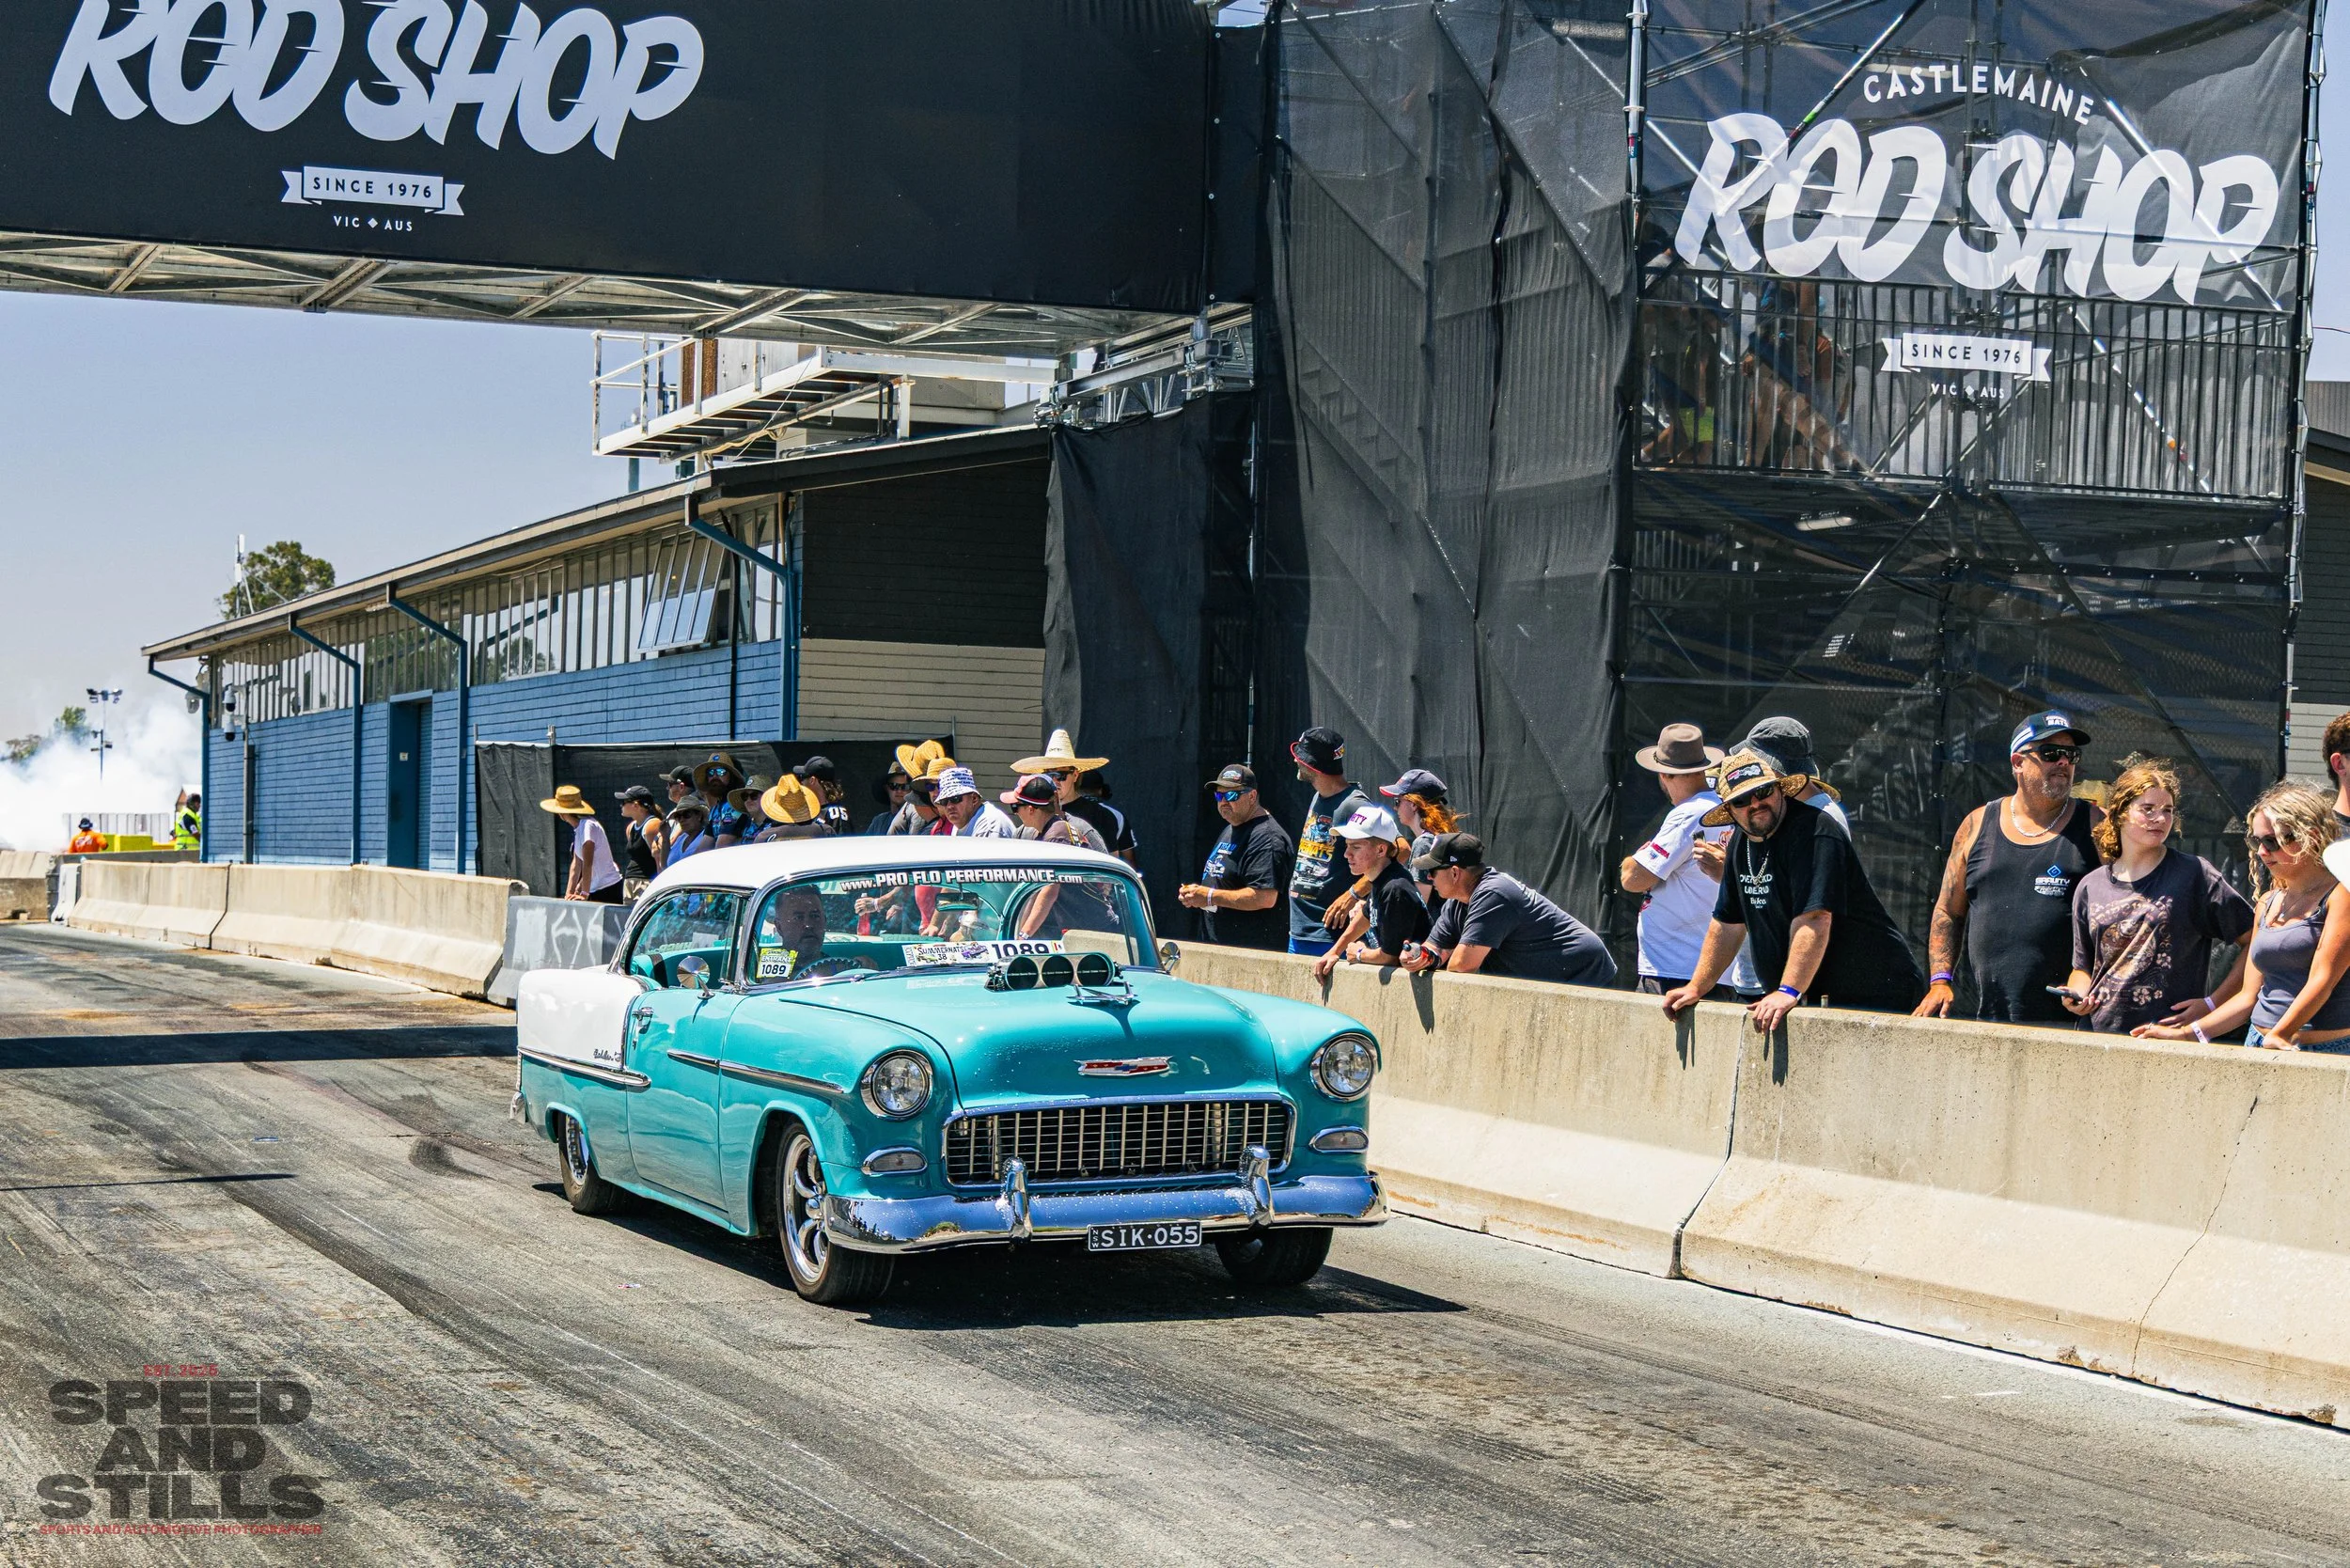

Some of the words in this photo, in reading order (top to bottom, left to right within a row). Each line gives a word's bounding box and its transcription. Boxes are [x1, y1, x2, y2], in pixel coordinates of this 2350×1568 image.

[49, 0, 345, 132] ROD
[344, 0, 704, 160] SHOP
[1863, 64, 2094, 125] CASTLEMAINE
[313, 177, 374, 195] SINCE
[387, 181, 432, 198] 1976
[1676, 113, 1948, 282] ROD
[1943, 134, 2279, 305] SHOP
[333, 215, 360, 227] VIC
[384, 219, 413, 231] AUS
[1911, 343, 1971, 361] SINCE
[1983, 348, 2021, 364] 1976
[1930, 383, 1958, 396] VIC
[1980, 385, 2005, 399] AUS
[839, 871, 908, 891] www.PRO
[912, 870, 942, 885] FLO
[944, 869, 1084, 884] PERFORMANCE.com
[761, 964, 787, 976] 1089
